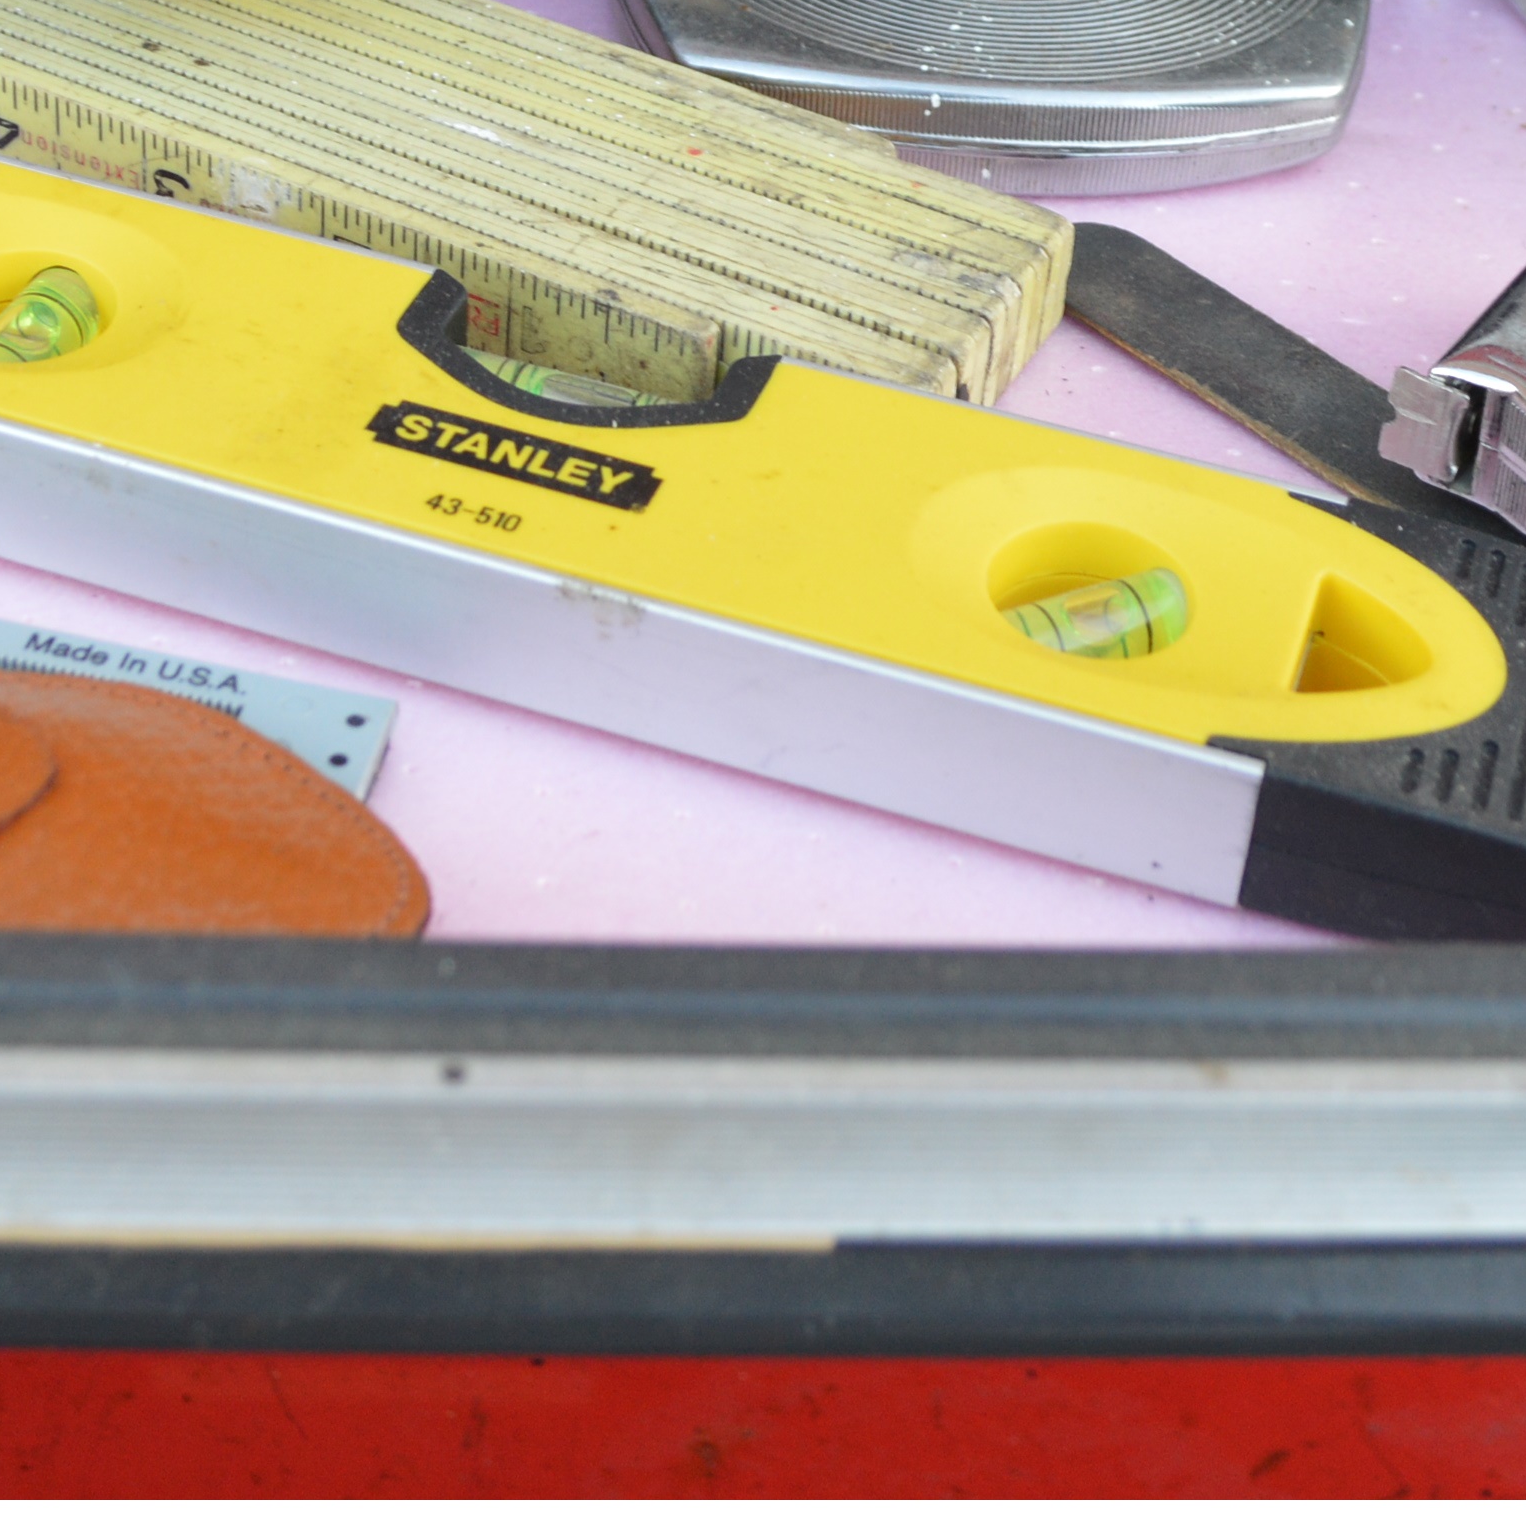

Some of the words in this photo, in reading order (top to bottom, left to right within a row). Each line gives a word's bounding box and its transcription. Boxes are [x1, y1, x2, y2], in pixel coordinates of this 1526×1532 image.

[20, 128, 140, 191] Extension
[394, 413, 635, 496] STANLEY
[425, 493, 523, 533] 43-510
[25, 632, 110, 666] Made
[157, 659, 248, 696] U.S.A.
